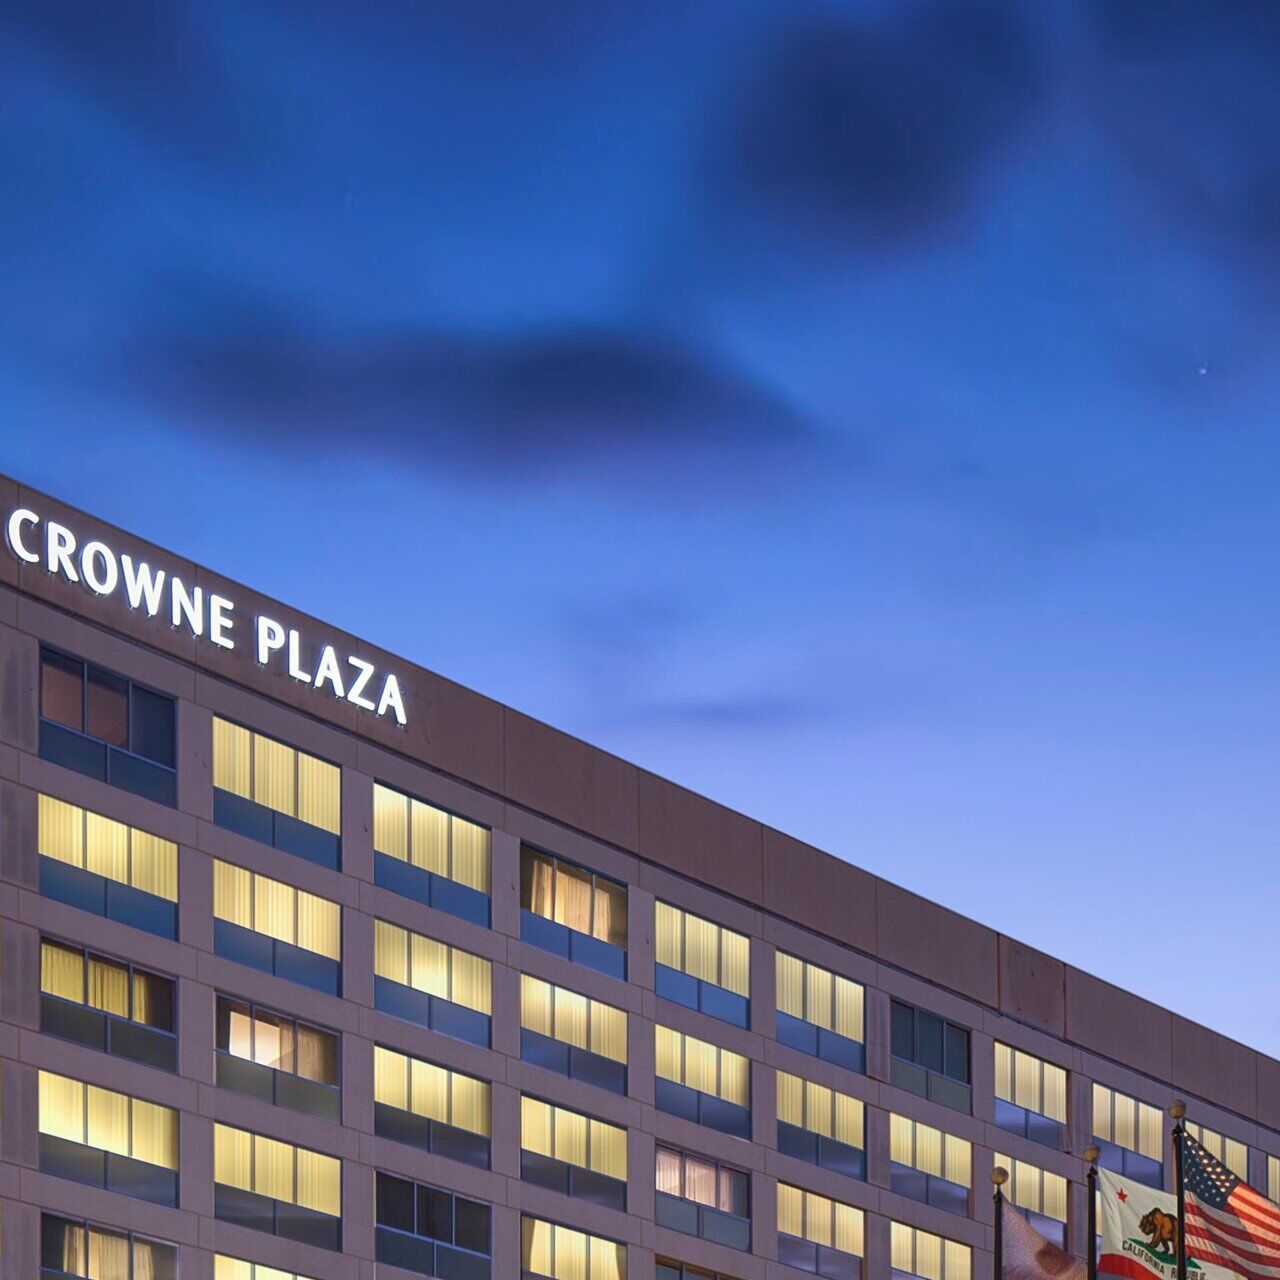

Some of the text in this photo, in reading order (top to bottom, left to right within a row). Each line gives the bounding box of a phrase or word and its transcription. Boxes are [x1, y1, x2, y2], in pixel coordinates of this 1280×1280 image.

[7, 509, 408, 725] CROWNE PLAZA
[1122, 1240, 1165, 1275] CALIFORNIA
